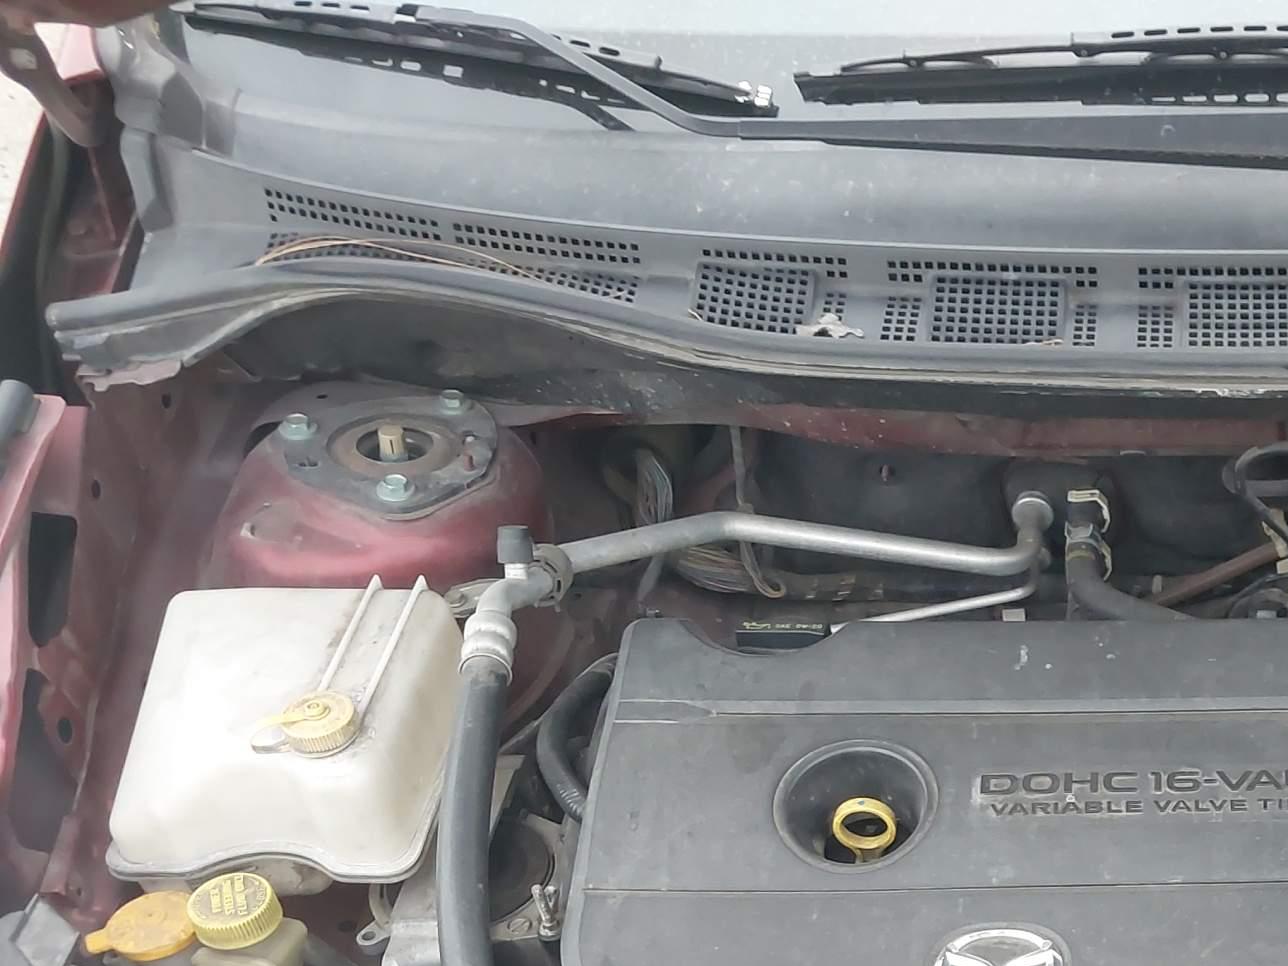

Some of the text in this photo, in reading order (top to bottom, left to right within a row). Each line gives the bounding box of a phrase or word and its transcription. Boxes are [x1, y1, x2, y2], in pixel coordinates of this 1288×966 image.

[979, 771, 1139, 796] DOHC
[990, 798, 1144, 816] VARIABLE
[1155, 797, 1248, 813] VALVE
